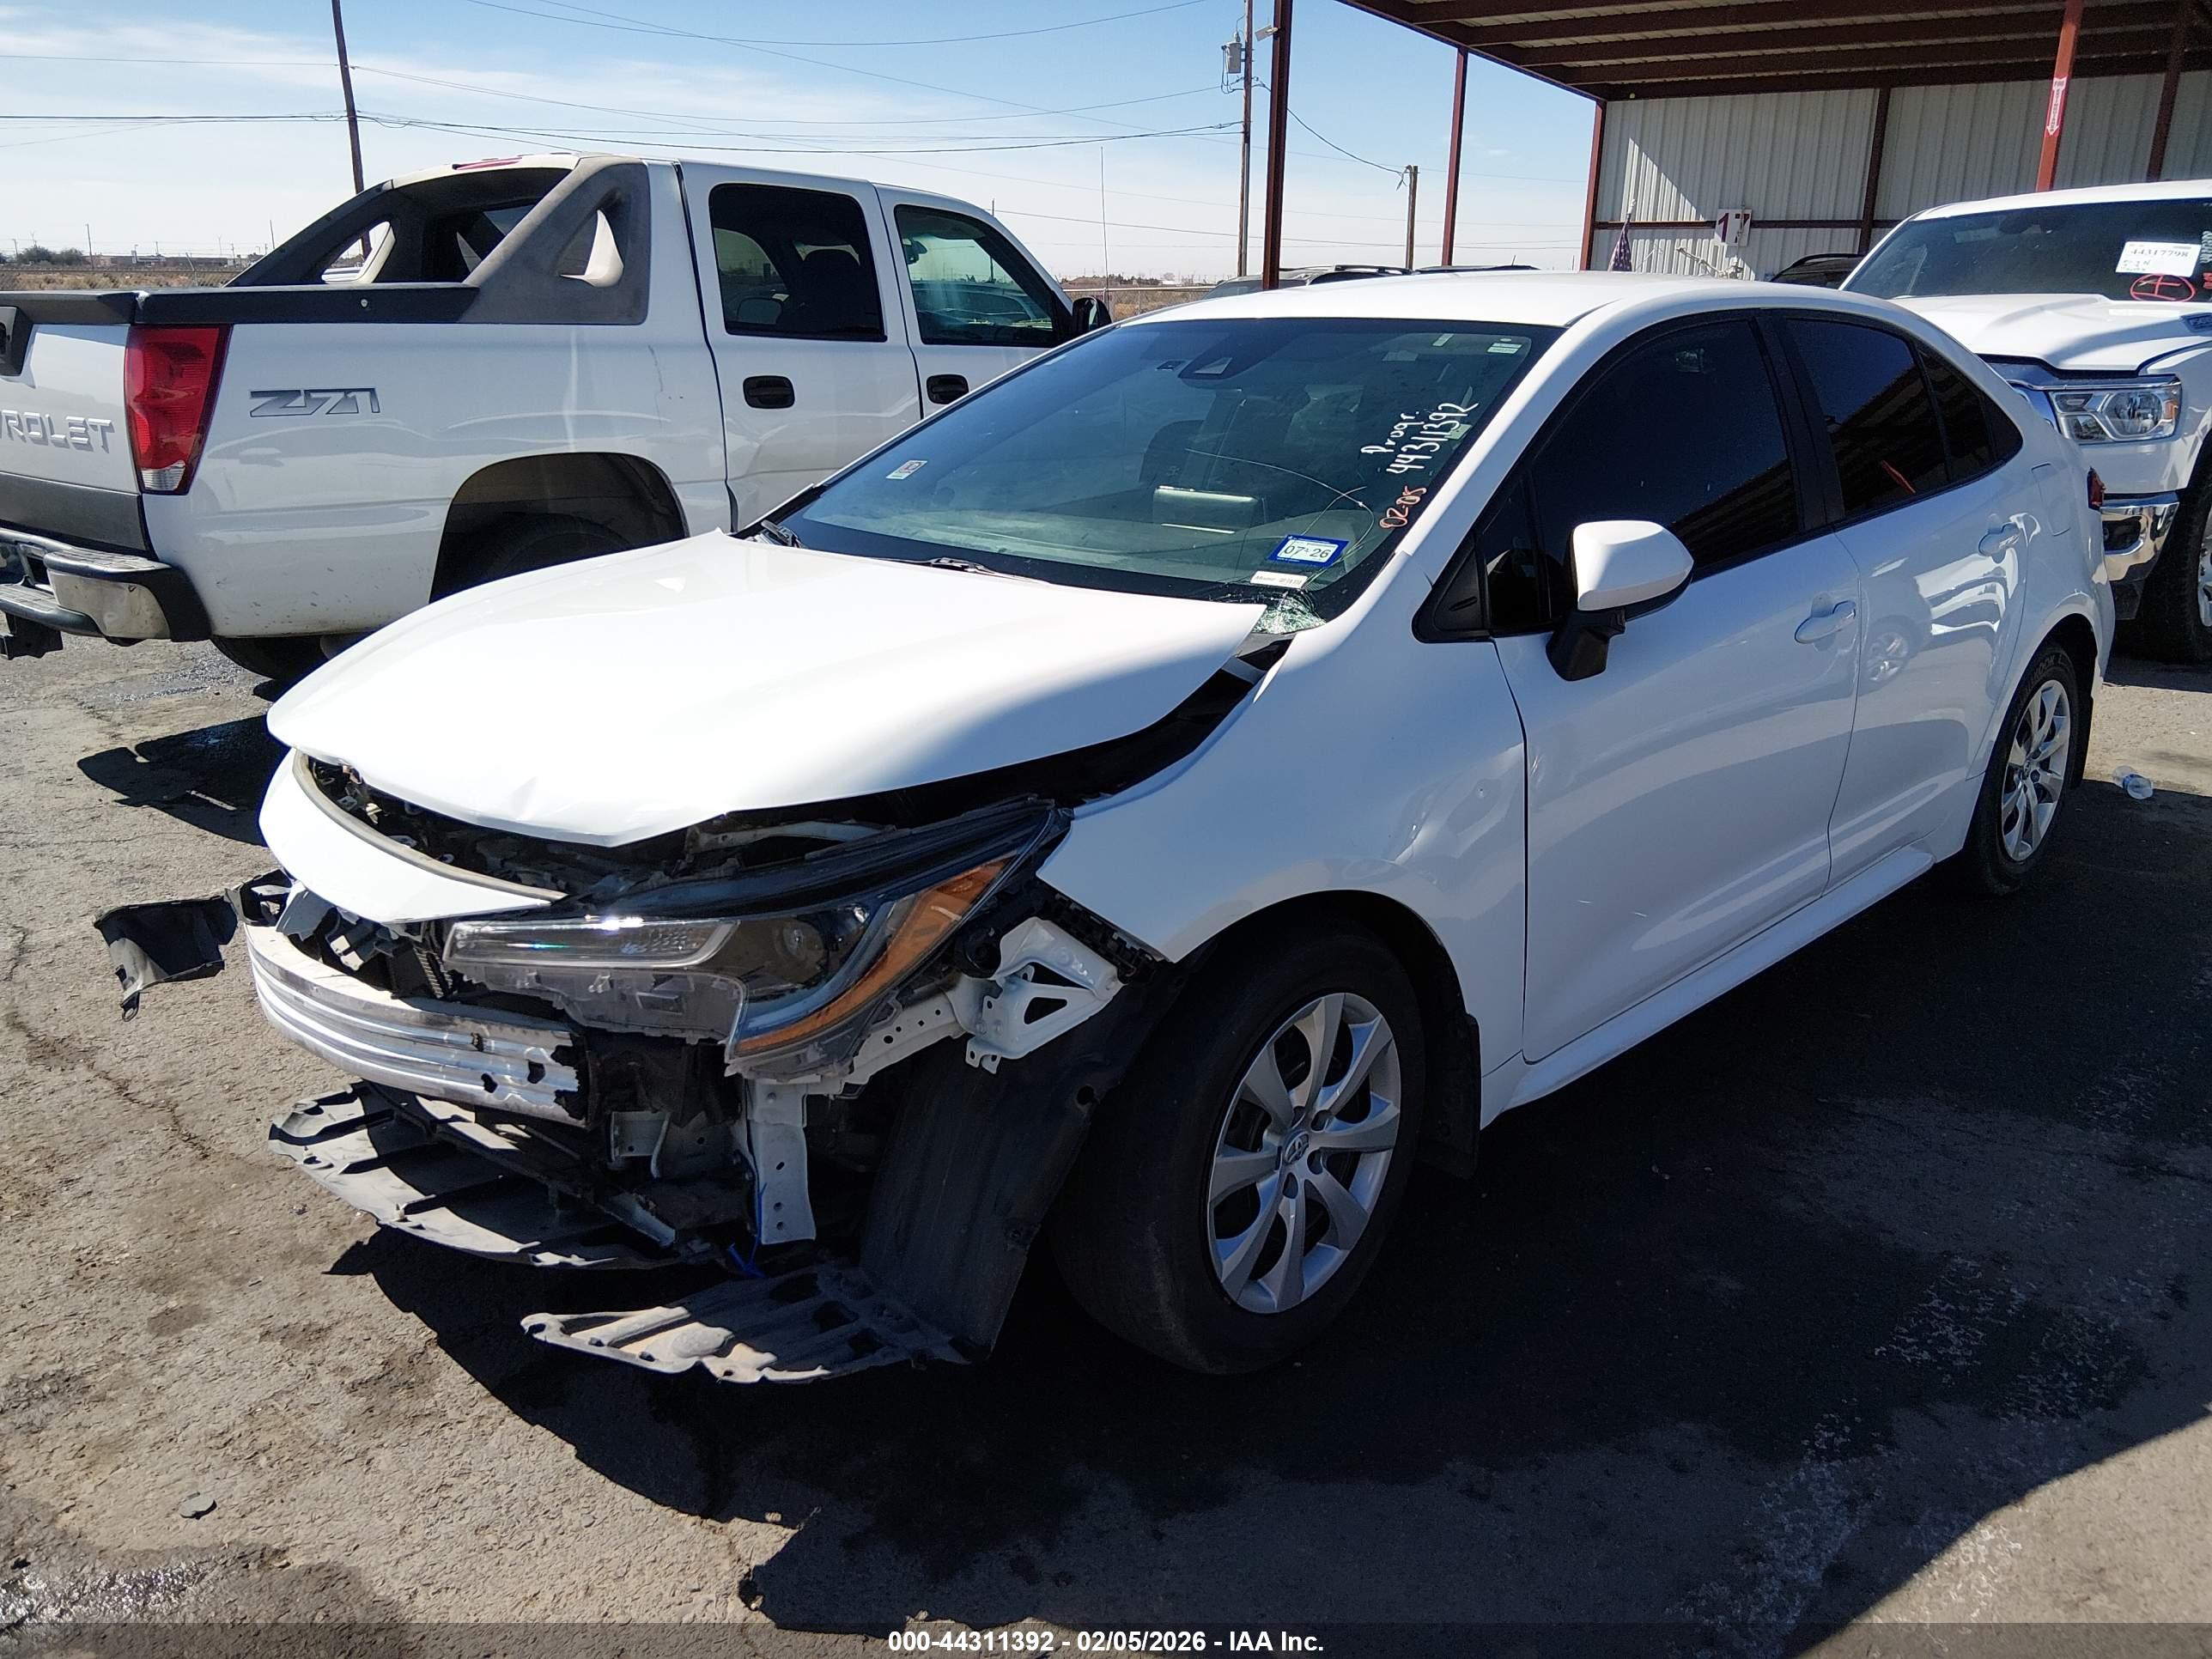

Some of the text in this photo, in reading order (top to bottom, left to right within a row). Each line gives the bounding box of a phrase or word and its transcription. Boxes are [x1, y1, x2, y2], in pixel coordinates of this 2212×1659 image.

[1718, 212, 1750, 243] 17
[250, 387, 380, 418] Z71
[0, 409, 115, 453] ROLET
[1386, 403, 1480, 474] 44311392
